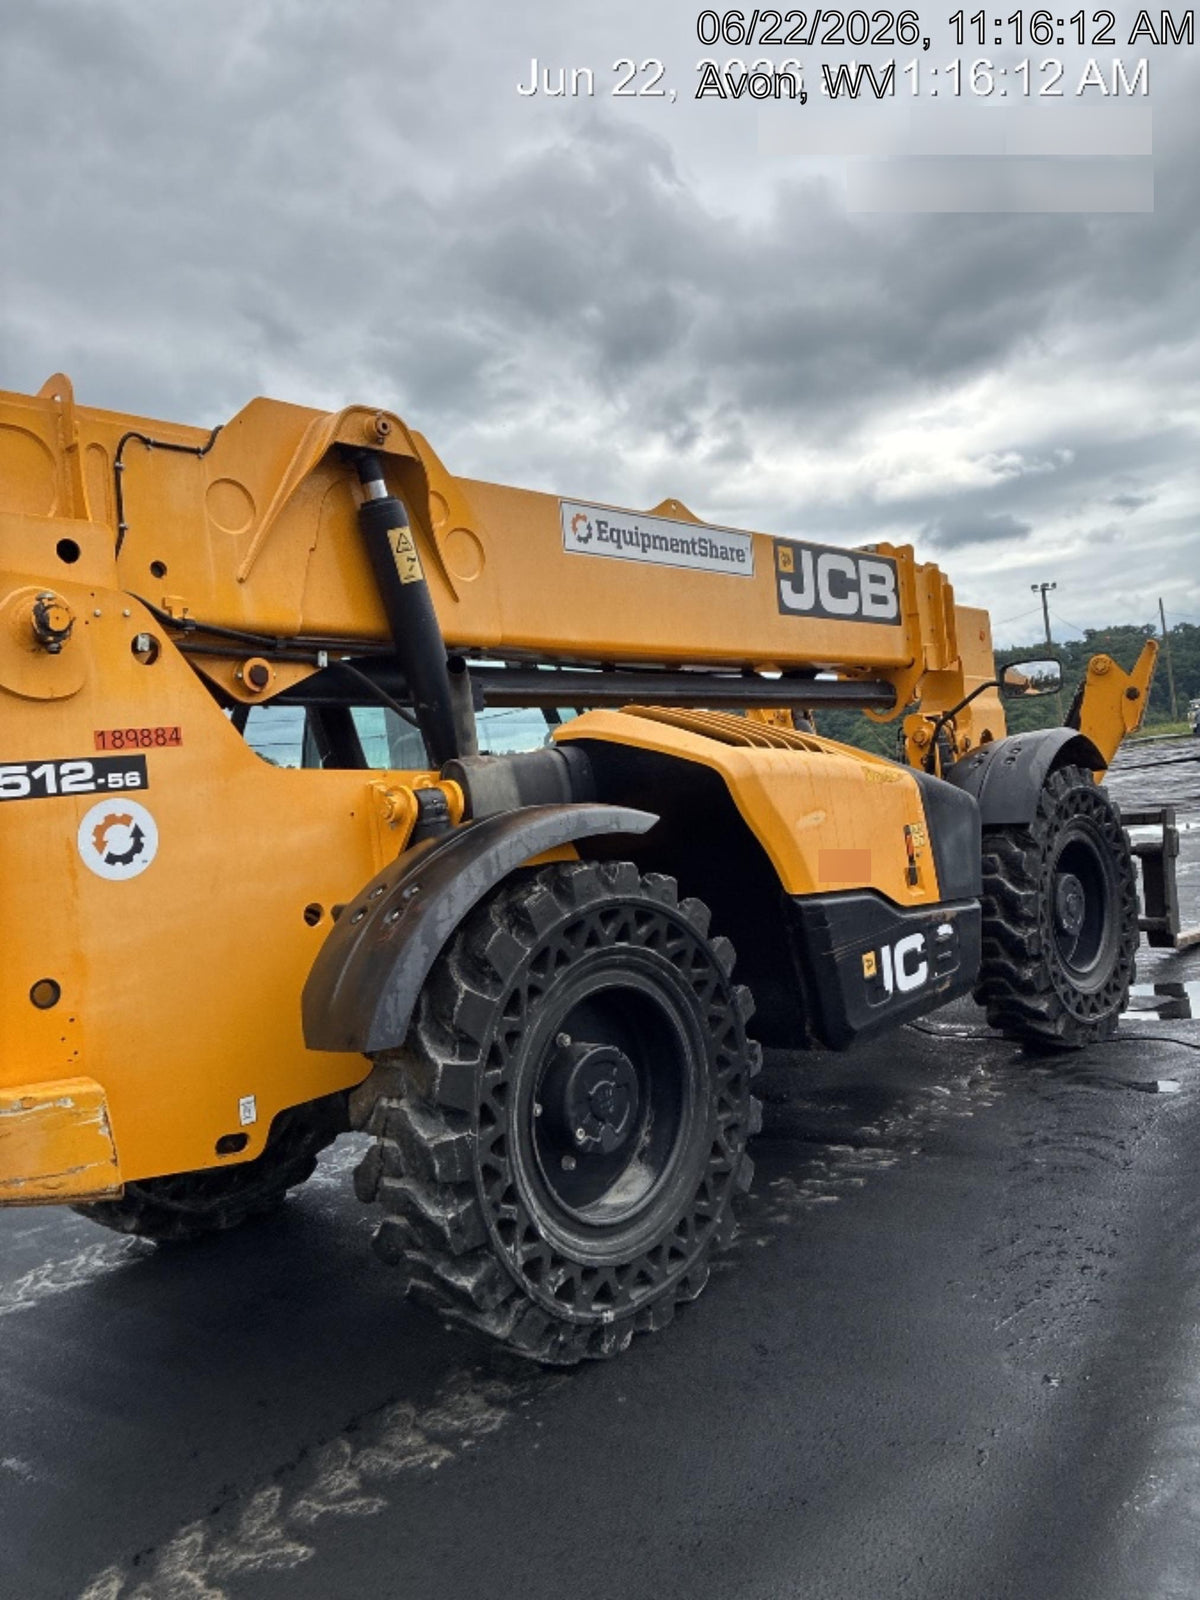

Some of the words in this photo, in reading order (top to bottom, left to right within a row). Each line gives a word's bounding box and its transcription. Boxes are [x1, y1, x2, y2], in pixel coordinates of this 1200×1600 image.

[595, 519, 746, 563] EquipmentShare
[780, 549, 898, 619] JCB
[97, 726, 181, 749] 189884
[0, 761, 142, 798] 512-56
